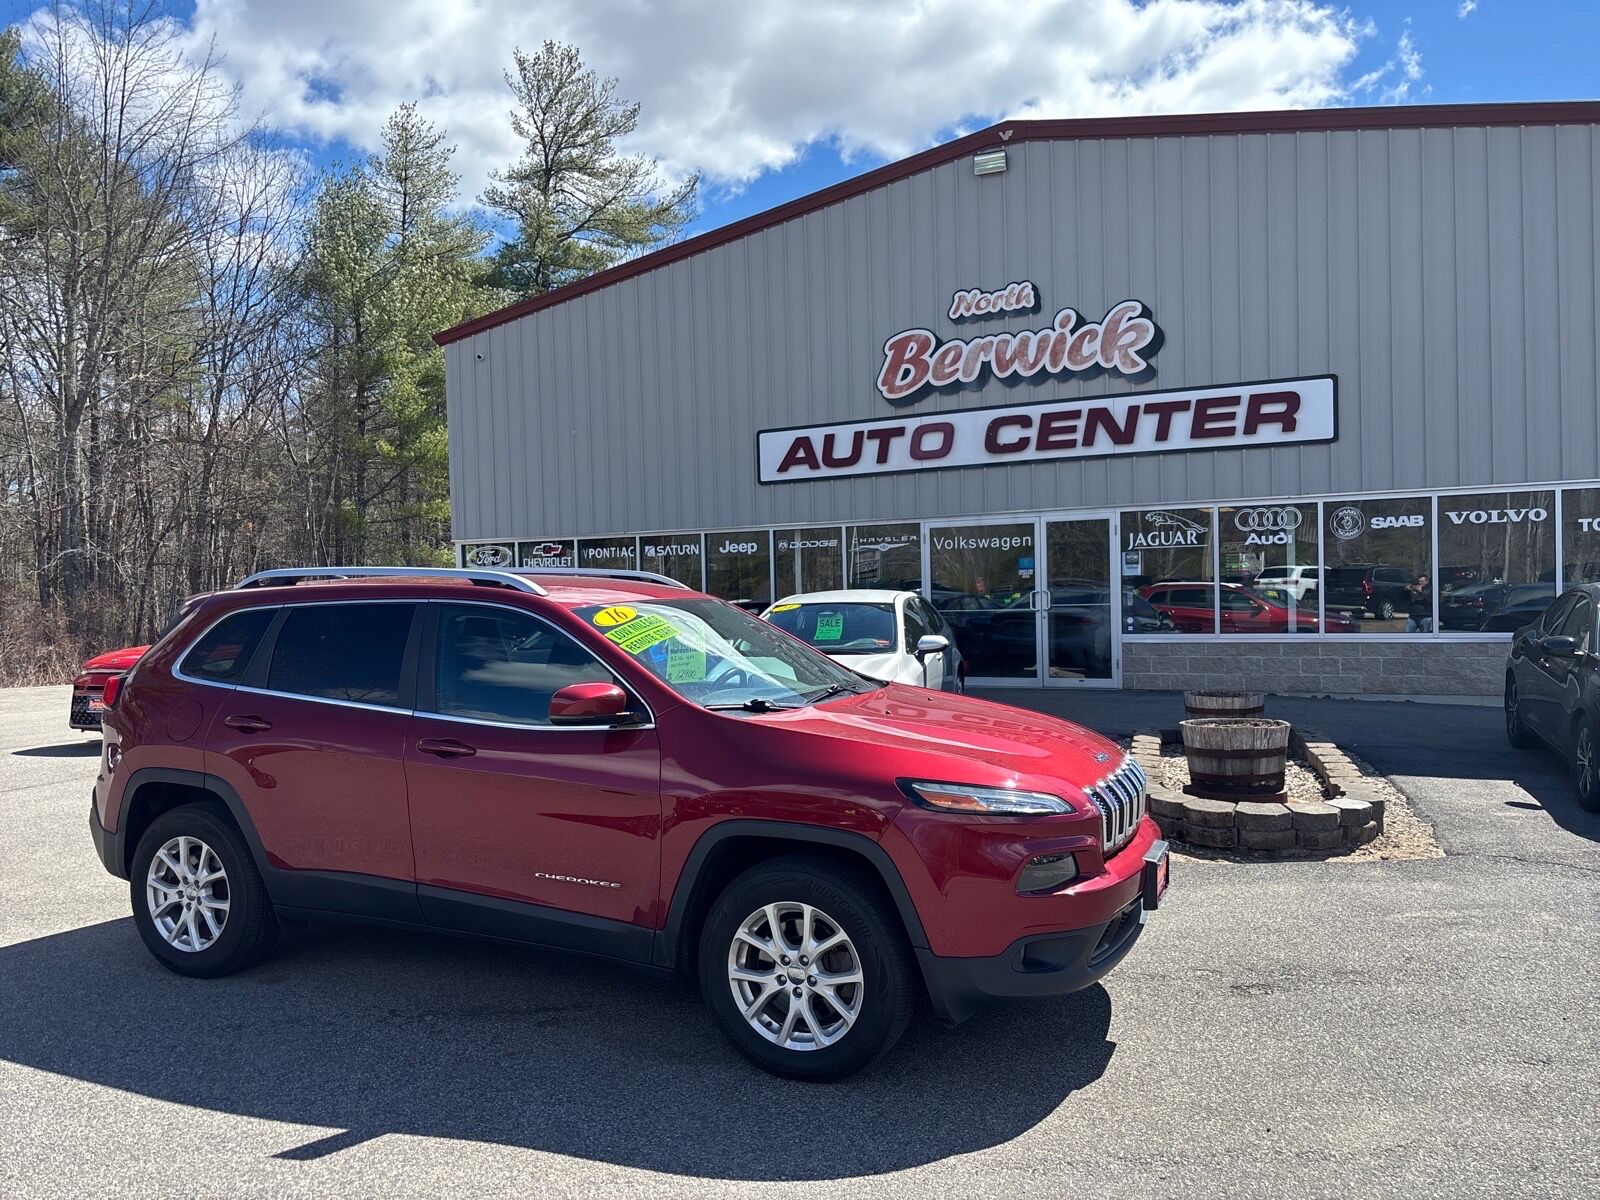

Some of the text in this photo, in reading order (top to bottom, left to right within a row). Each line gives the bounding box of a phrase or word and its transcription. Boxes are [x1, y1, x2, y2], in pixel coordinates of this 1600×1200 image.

[950, 281, 1036, 319] North
[879, 299, 1156, 398] Berwick
[777, 391, 1302, 473] AUTO CENTER
[1370, 514, 1425, 529] SAAB
[1445, 508, 1548, 525] VOLVO
[789, 539, 839, 549] DODGE
[934, 534, 1032, 551] Volkswagen
[1128, 531, 1198, 550] JAGUAR
[1245, 532, 1293, 545] Audi
[588, 546, 635, 559] PONTIAC
[656, 544, 700, 556] SATURN
[719, 540, 758, 555] Jeep
[476, 550, 502, 565] Ford
[523, 557, 572, 567] CHEVROLET
[605, 608, 629, 623] 16
[819, 619, 841, 628] SALE
[611, 626, 631, 639] LOW
[625, 634, 656, 652] REMOTE
[534, 872, 621, 888] CHEROKEE
